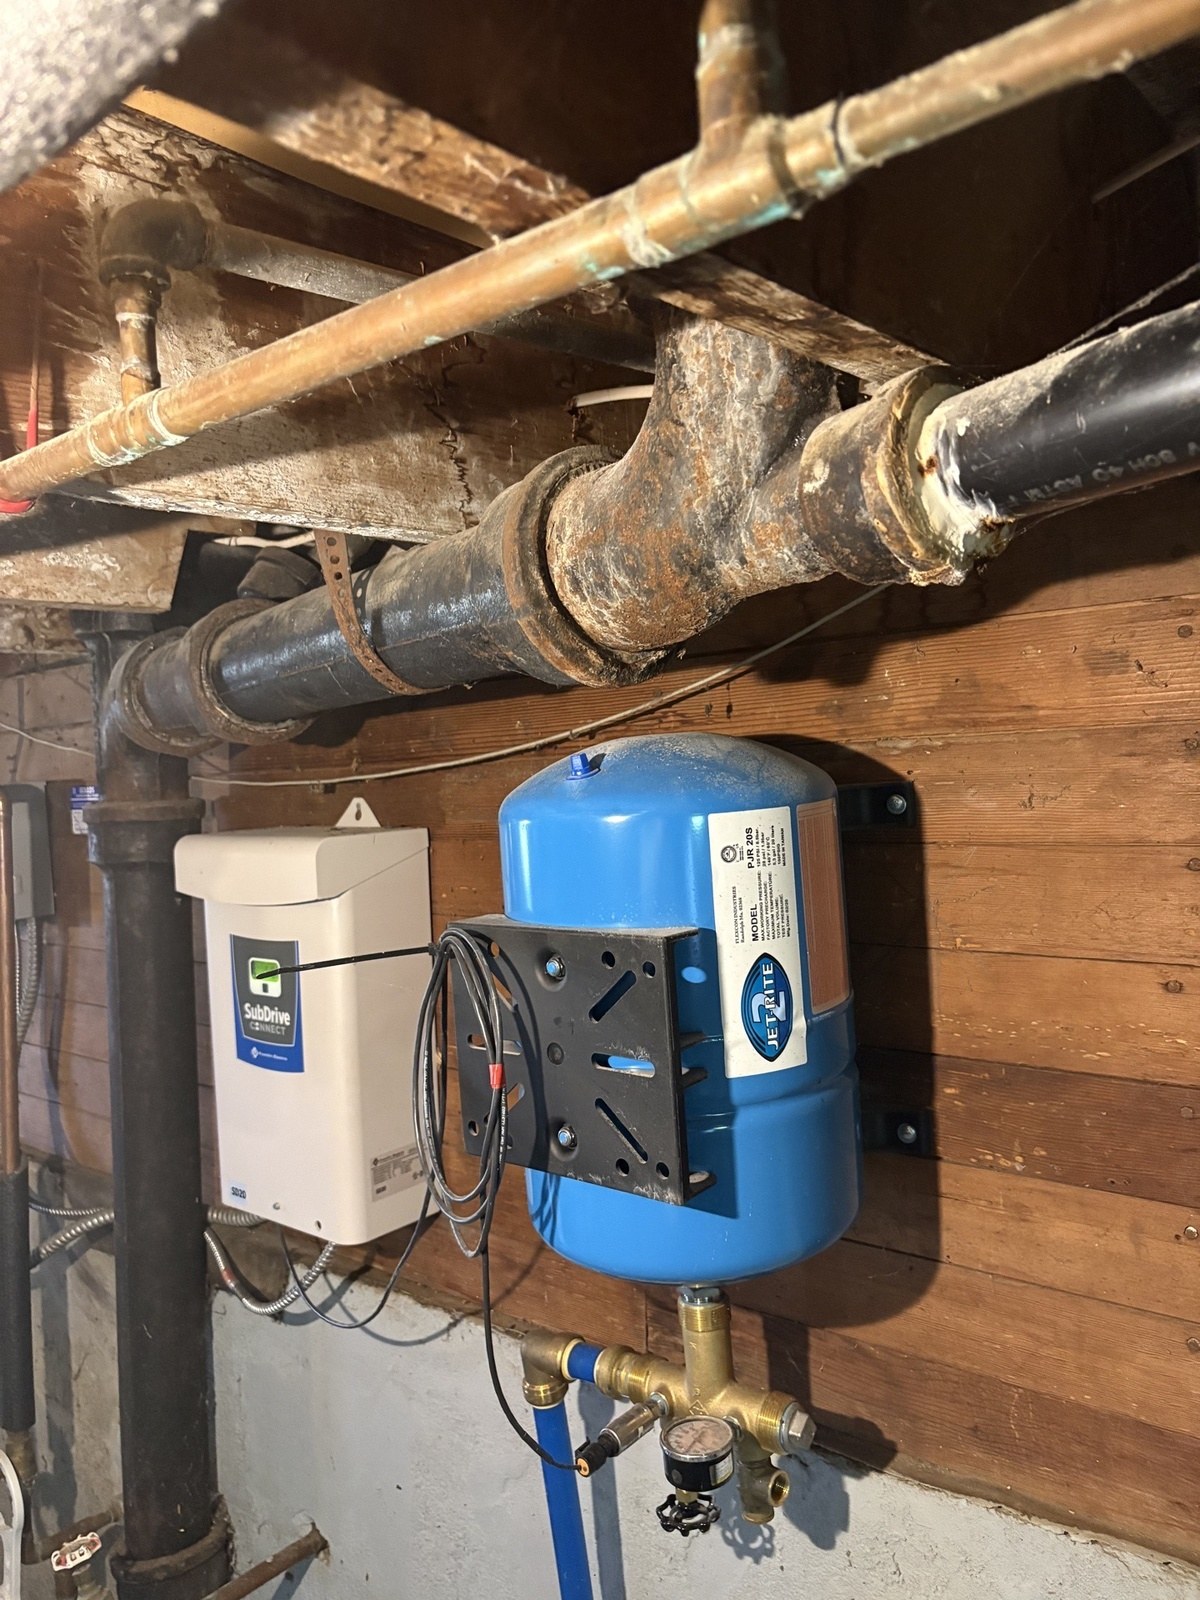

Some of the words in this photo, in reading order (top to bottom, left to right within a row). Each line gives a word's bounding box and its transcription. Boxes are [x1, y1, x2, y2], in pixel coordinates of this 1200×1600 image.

[750, 904, 759, 941] MODEL
[244, 1002, 291, 1026] SubDrive
[762, 963, 778, 1050] JET-RITE
[250, 1021, 286, 1036] CONNECT
[231, 1186, 247, 1199] SD20
